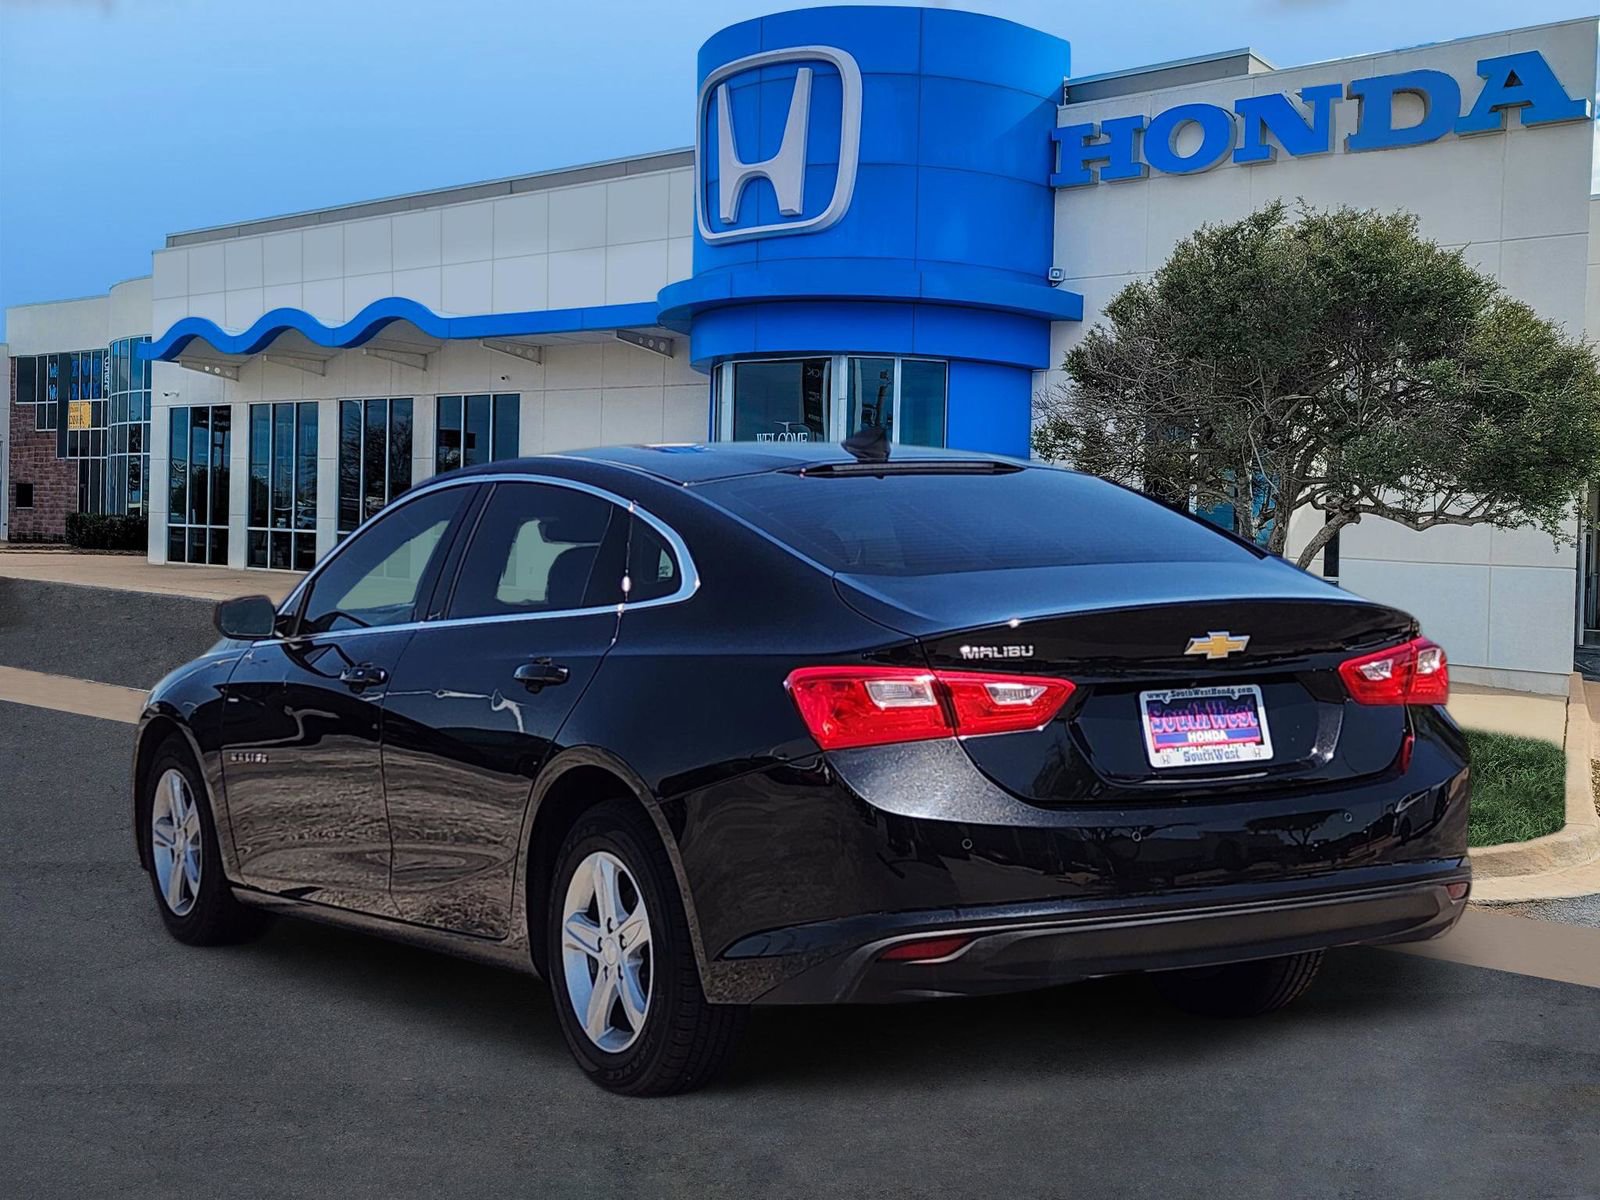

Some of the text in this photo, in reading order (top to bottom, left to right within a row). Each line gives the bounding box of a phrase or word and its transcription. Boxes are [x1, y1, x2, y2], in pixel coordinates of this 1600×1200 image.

[1050, 50, 1592, 188] HONDA
[960, 645, 1034, 660] MALIBU
[1148, 700, 1258, 733] SouthWest
[1187, 729, 1228, 743] HONDA
[1183, 748, 1240, 762] SouthWest
